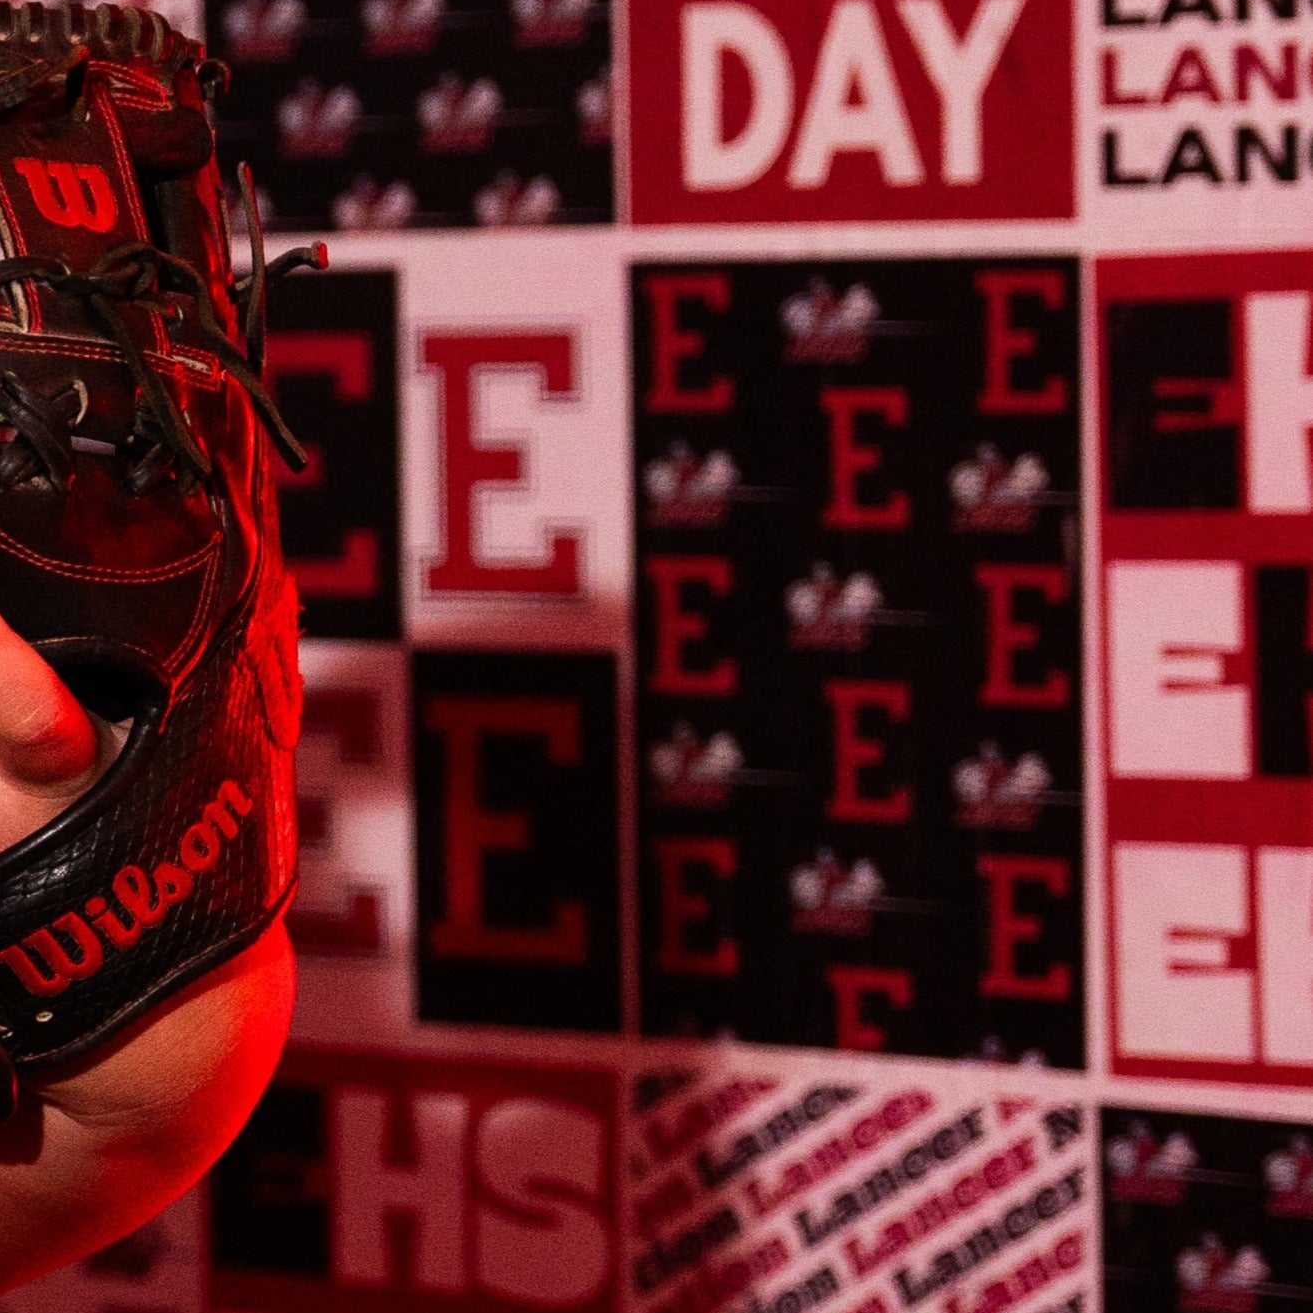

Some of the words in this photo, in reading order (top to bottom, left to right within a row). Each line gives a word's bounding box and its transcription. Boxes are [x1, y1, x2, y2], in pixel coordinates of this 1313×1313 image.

[1098, 42, 1313, 110] LAN
[1098, 123, 1313, 189] LAN
[645, 273, 736, 414] E
[978, 270, 1070, 414] E
[423, 331, 582, 599] E
[820, 387, 911, 531] E
[647, 555, 738, 697] E
[978, 564, 1070, 708] E
[825, 681, 913, 824] E
[424, 698, 587, 964] E
[653, 837, 740, 976] E
[981, 856, 1073, 1001] E
[211, 1092, 609, 1308] EHS
[793, 1107, 986, 1250] Lancer
[839, 1134, 1039, 1283] Lancer
[891, 1166, 1085, 1309] Lancer
